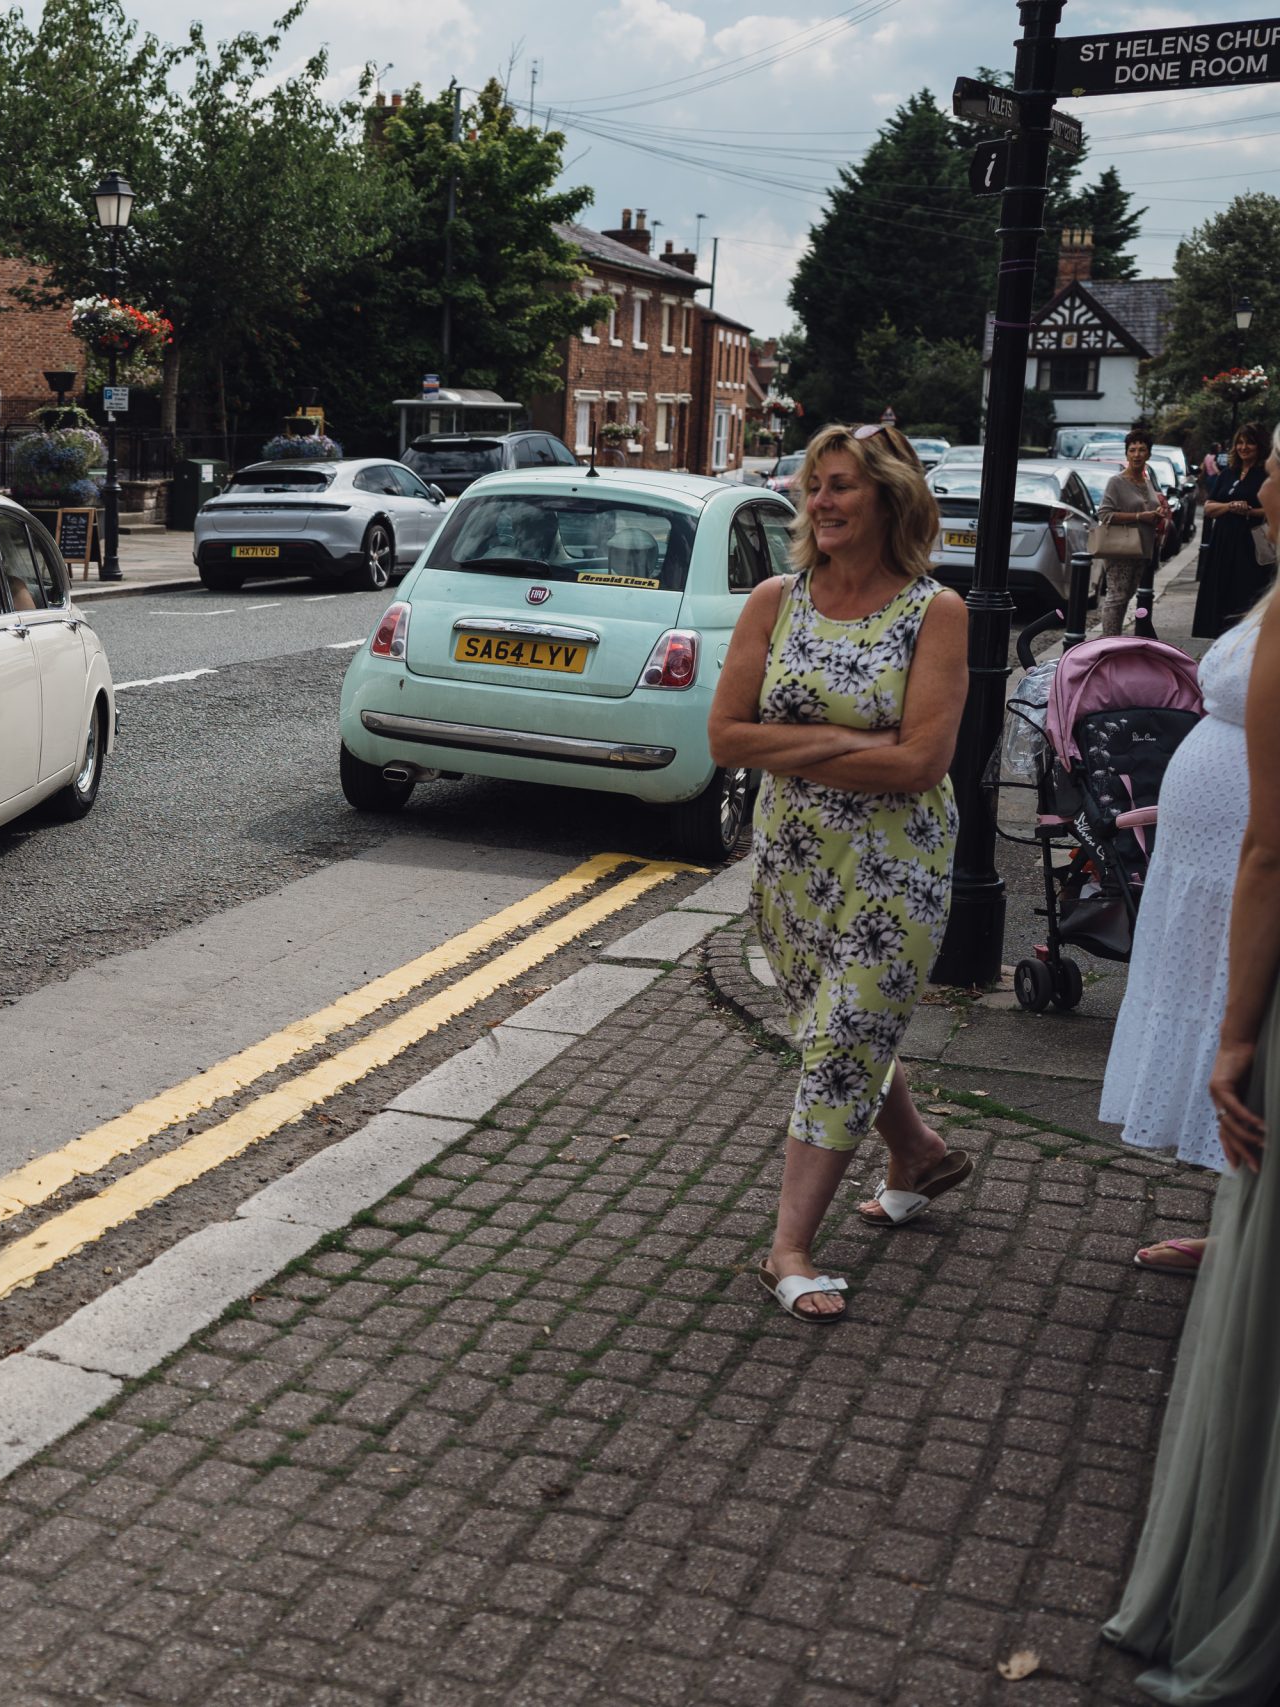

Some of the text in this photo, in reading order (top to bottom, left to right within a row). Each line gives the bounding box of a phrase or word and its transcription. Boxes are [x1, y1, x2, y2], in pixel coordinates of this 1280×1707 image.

[1080, 42, 1109, 62] ST
[1115, 34, 1210, 59] HELENS
[1115, 54, 1268, 84] DONE ROOM
[988, 94, 1013, 118] TOILETS
[239, 545, 276, 556] HX71 YUS
[581, 574, 656, 587] Arnold Clark
[531, 589, 546, 599] FIAT
[464, 637, 578, 667] SA64 LYV
